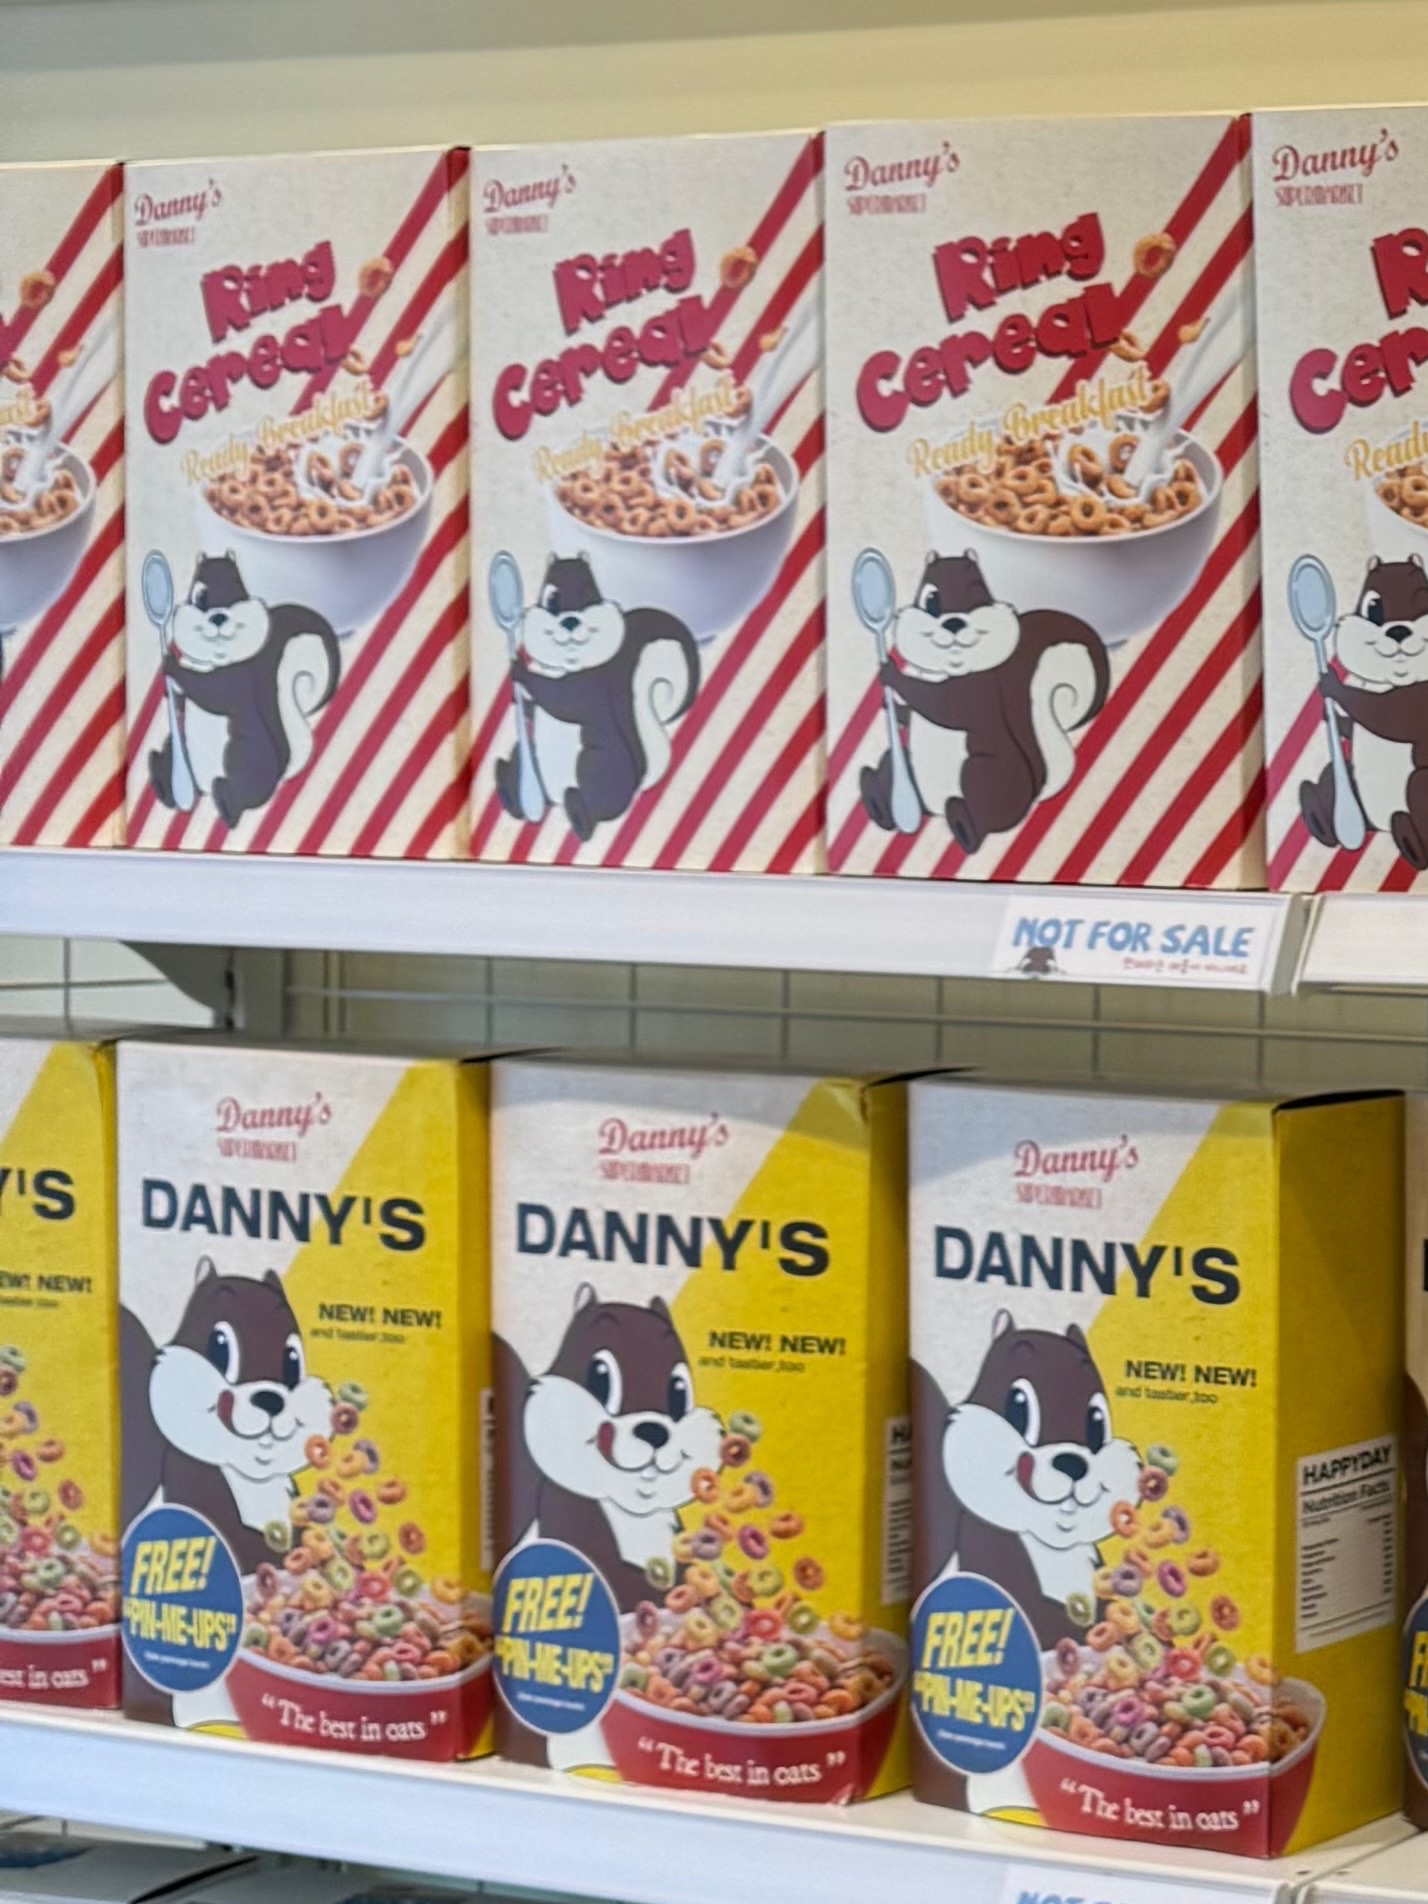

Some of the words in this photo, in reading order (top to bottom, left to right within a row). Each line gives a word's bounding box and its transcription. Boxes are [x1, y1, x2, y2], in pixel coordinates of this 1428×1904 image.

[844, 141, 960, 193] Danny's
[1272, 129, 1398, 183] Danny's
[135, 177, 223, 226] Danny's
[483, 164, 576, 214] Danny's
[201, 241, 337, 342] Ring
[552, 228, 696, 334] Ring
[931, 212, 1108, 322] Ring
[143, 304, 357, 445] Cereal
[493, 296, 717, 441] Cereal
[856, 283, 1131, 434] Cereal
[907, 425, 995, 477] Ready
[1004, 369, 1151, 434] Breakfast
[1013, 917, 1079, 950] NOT
[1088, 922, 1153, 954] FOR
[1162, 925, 1254, 958] SALE
[217, 1092, 332, 1138] Danny's
[599, 1113, 729, 1160] Danny's
[1015, 1135, 1139, 1182] Danny's
[142, 1178, 426, 1252] DANNY'S
[516, 1202, 831, 1277] DANNY'S
[935, 1226, 1241, 1305] DANNY'S
[319, 1303, 377, 1325] NEW!
[382, 1306, 442, 1329] NEW!
[709, 1331, 772, 1352] NEW!
[779, 1333, 846, 1357] NEW!
[1125, 1359, 1187, 1383] NEW!
[1194, 1364, 1257, 1388] NEW!
[1303, 1444, 1392, 1485] HAPPYDAY
[130, 1536, 217, 1594] FREE!
[502, 1574, 592, 1632] FREE!
[922, 1609, 1013, 1667] FREE!
